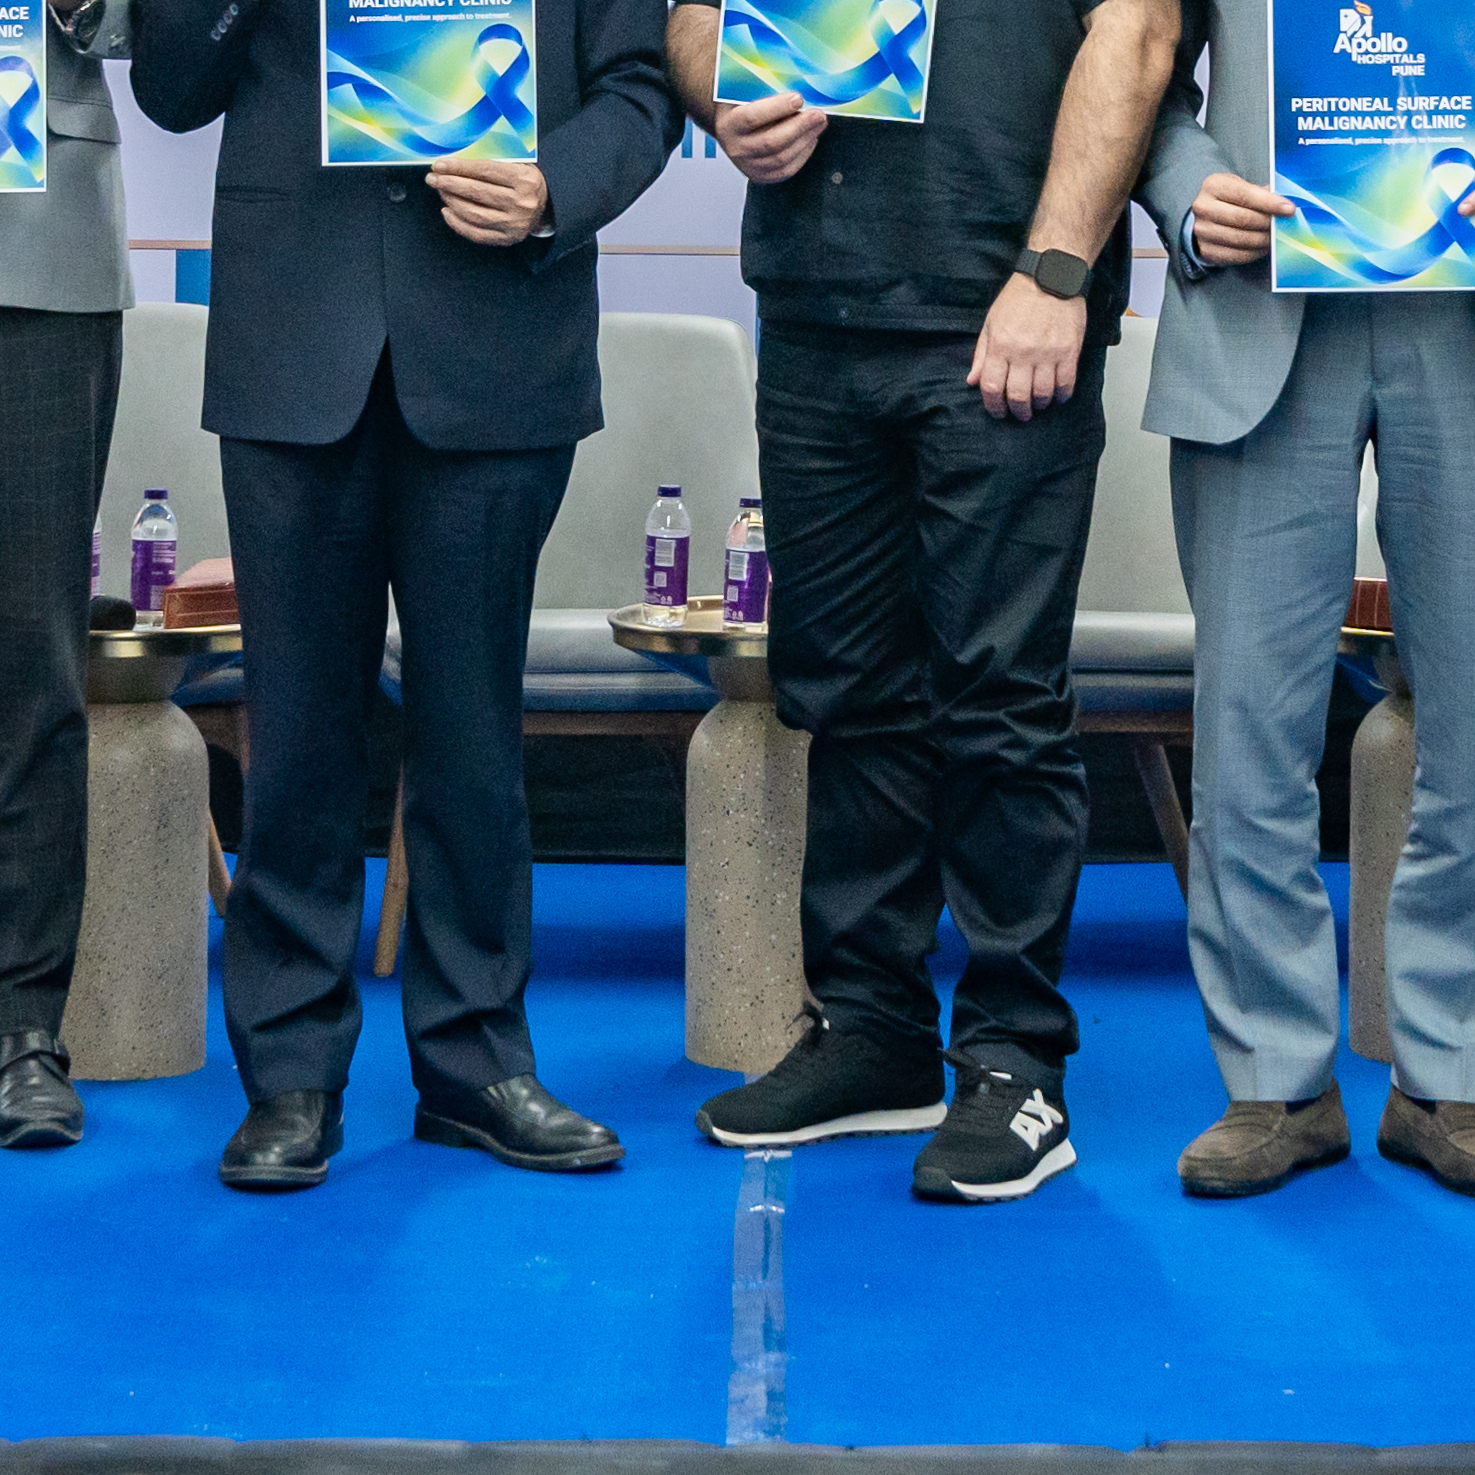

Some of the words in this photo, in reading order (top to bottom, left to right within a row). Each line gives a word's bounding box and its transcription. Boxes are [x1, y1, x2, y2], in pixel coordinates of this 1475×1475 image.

[1333, 32, 1408, 61] Apollo
[1356, 53, 1426, 65] HOSPITALS
[1391, 65, 1425, 76] PUNE
[1291, 97, 1394, 112] PERITONEAL
[1396, 95, 1473, 111] SURFACE
[1297, 115, 1408, 131] MALIGNANCY
[1410, 114, 1466, 129] CLINIC
